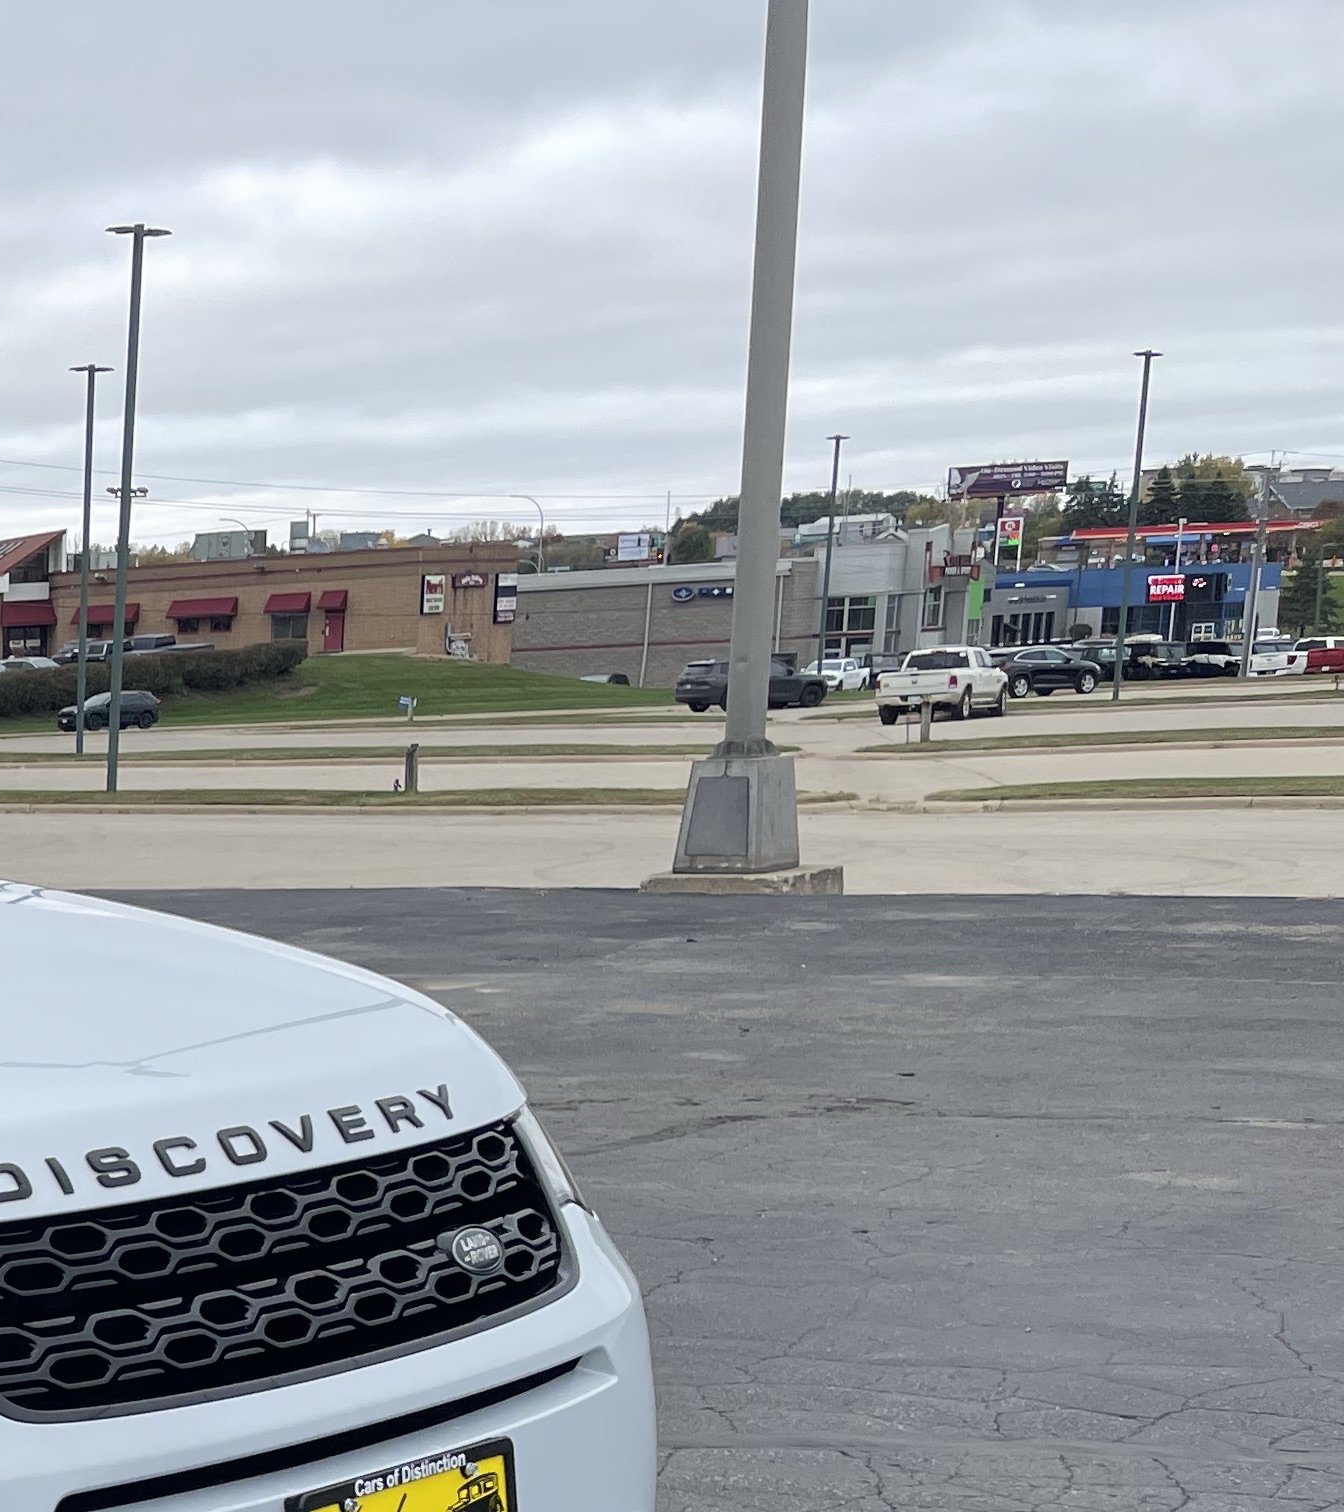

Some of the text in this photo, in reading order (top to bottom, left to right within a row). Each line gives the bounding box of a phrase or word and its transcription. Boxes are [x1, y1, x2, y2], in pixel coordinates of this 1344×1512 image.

[1150, 584, 1185, 596] REPAIR
[354, 1453, 467, 1497] Cars of Distinction
